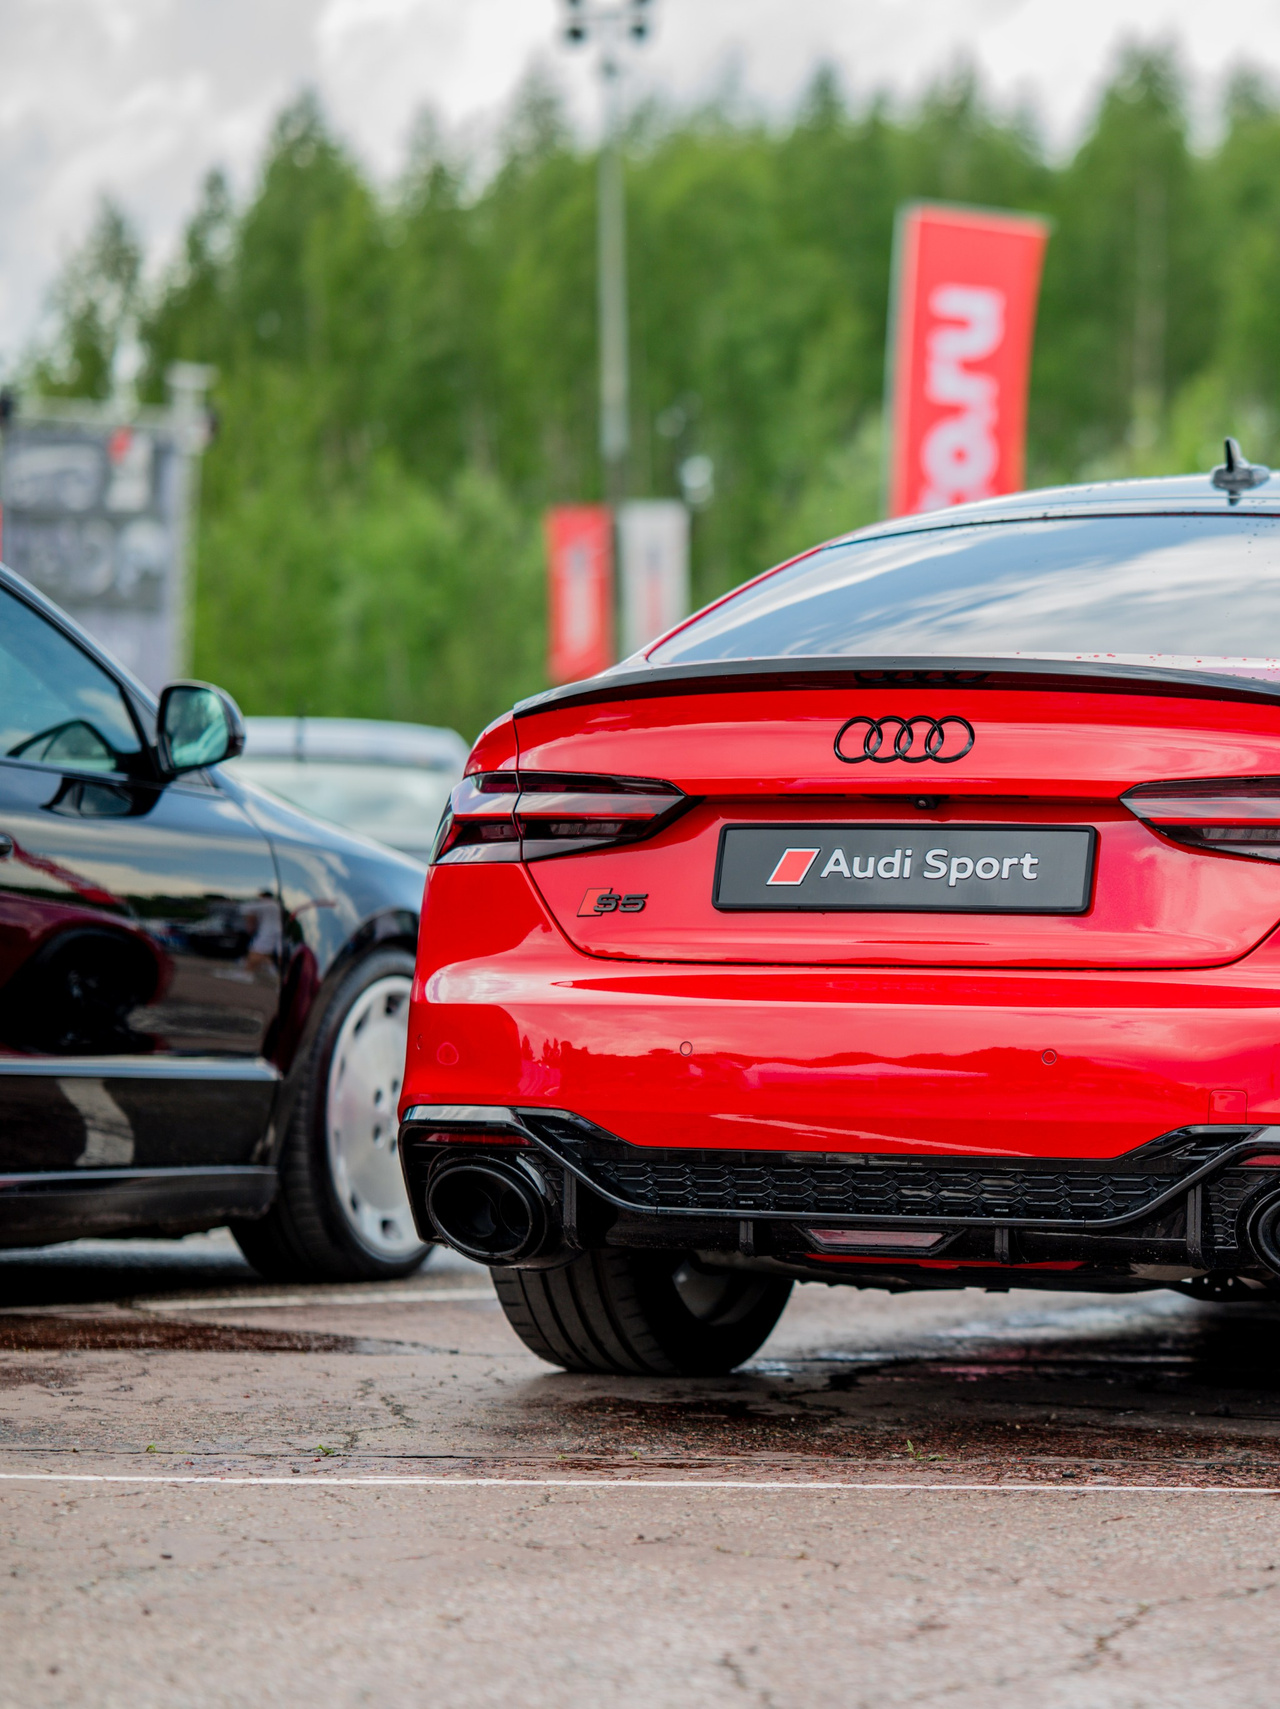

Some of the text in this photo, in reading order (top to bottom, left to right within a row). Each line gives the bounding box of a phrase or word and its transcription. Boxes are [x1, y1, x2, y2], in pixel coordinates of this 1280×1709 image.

[820, 848, 1039, 887] Audi Sport
[593, 893, 649, 913] S5
